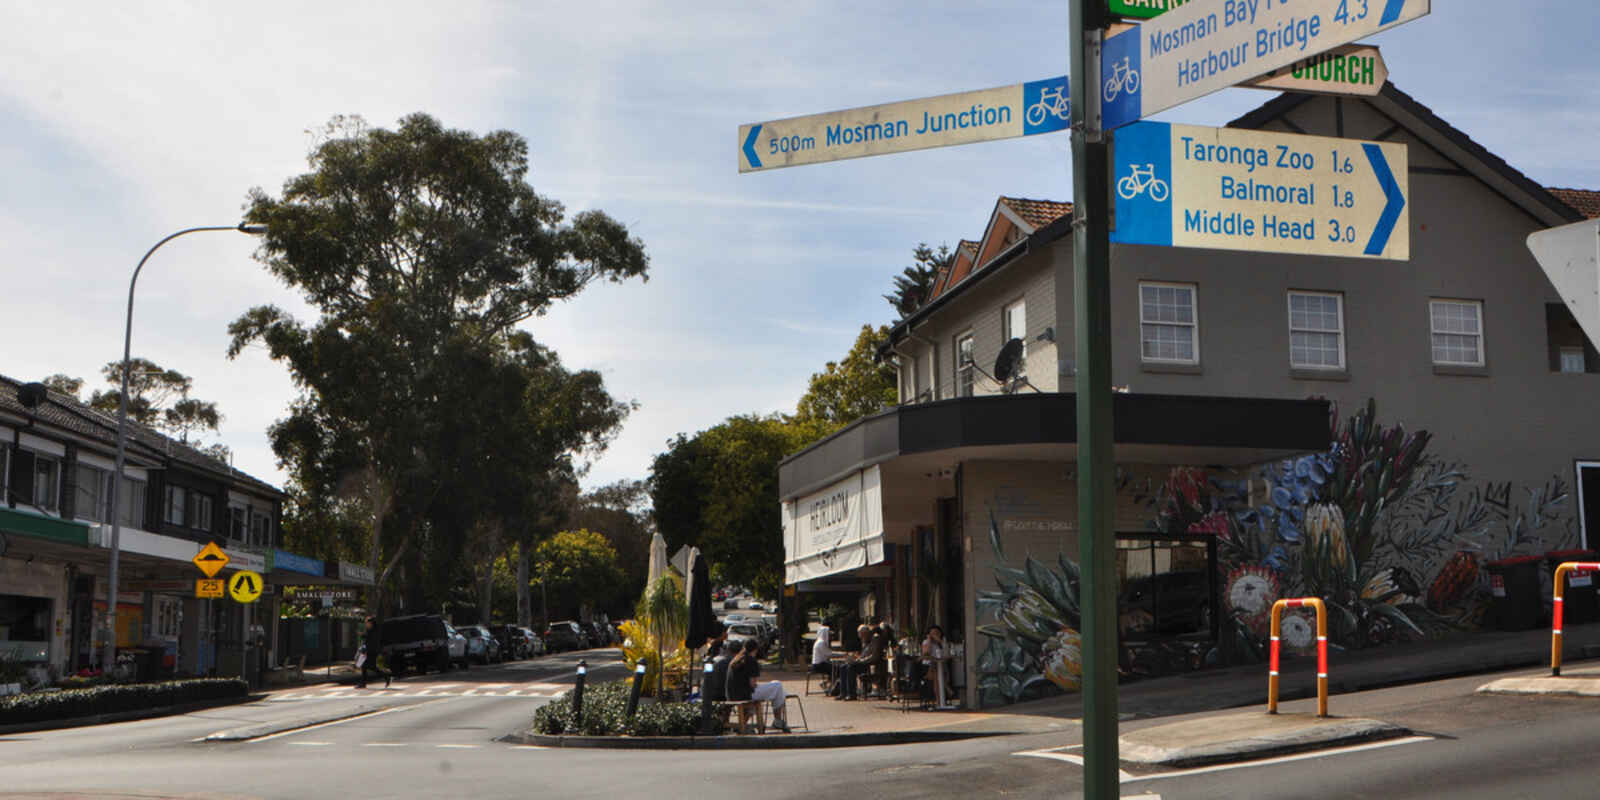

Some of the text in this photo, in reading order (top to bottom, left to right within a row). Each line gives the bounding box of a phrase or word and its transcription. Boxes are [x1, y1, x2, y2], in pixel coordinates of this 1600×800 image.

[1149, 0, 1258, 58] Mosman Bay
[1178, 0, 1368, 87] Harbour Bridge 4.3
[1292, 52, 1375, 85] CHURCH
[769, 103, 1010, 155] 500m Mosman Junction
[1180, 136, 1354, 173] Taronga Zoo 1.6
[1221, 176, 1354, 208] Balmoral 1.8
[1184, 209, 1356, 243] Middle Head 3.0
[809, 489, 848, 533] HEIRLOOM
[202, 580, 218, 591] 25
